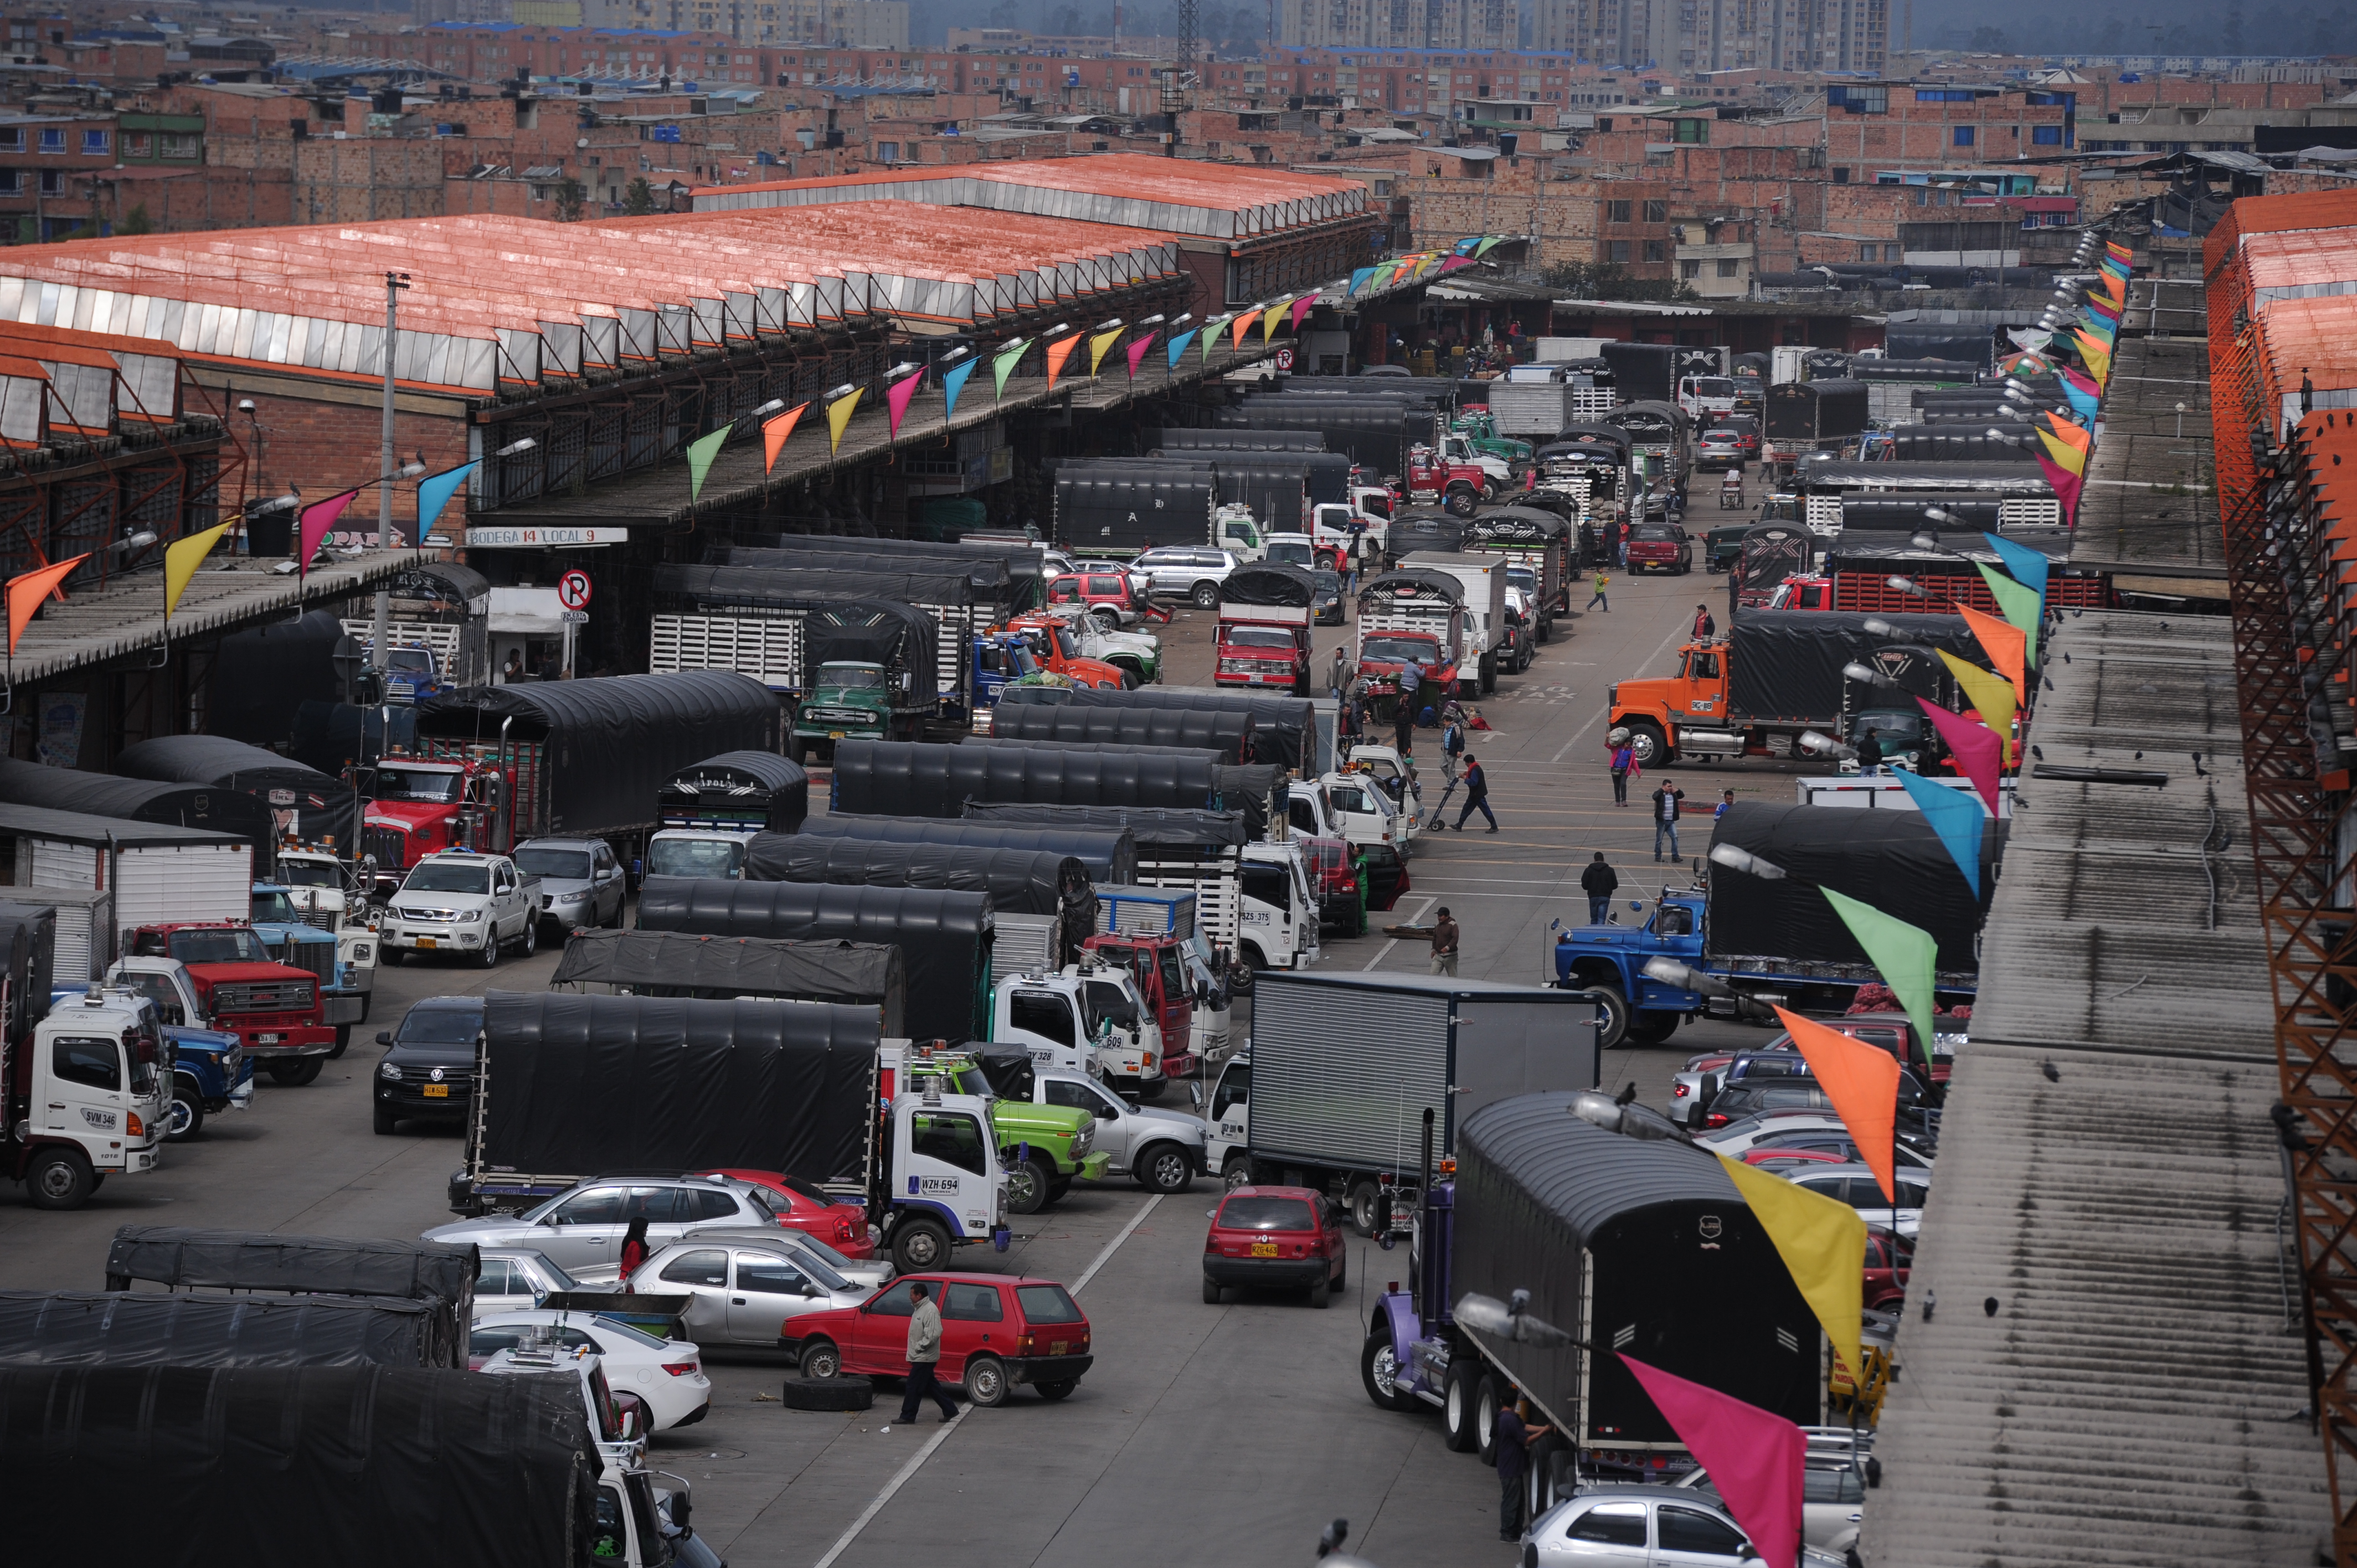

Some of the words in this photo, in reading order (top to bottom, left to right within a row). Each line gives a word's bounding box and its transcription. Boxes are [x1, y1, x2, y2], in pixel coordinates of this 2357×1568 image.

[1128, 513, 1138, 522] A
[472, 532, 518, 544] BODEGA
[523, 531, 536, 543] 14
[543, 531, 581, 543] LOCAL
[586, 529, 594, 541] 9
[569, 576, 585, 604] P
[87, 1112, 101, 1123] SVM
[103, 1115, 115, 1125] 346
[922, 1179, 956, 1189] WZH-694
